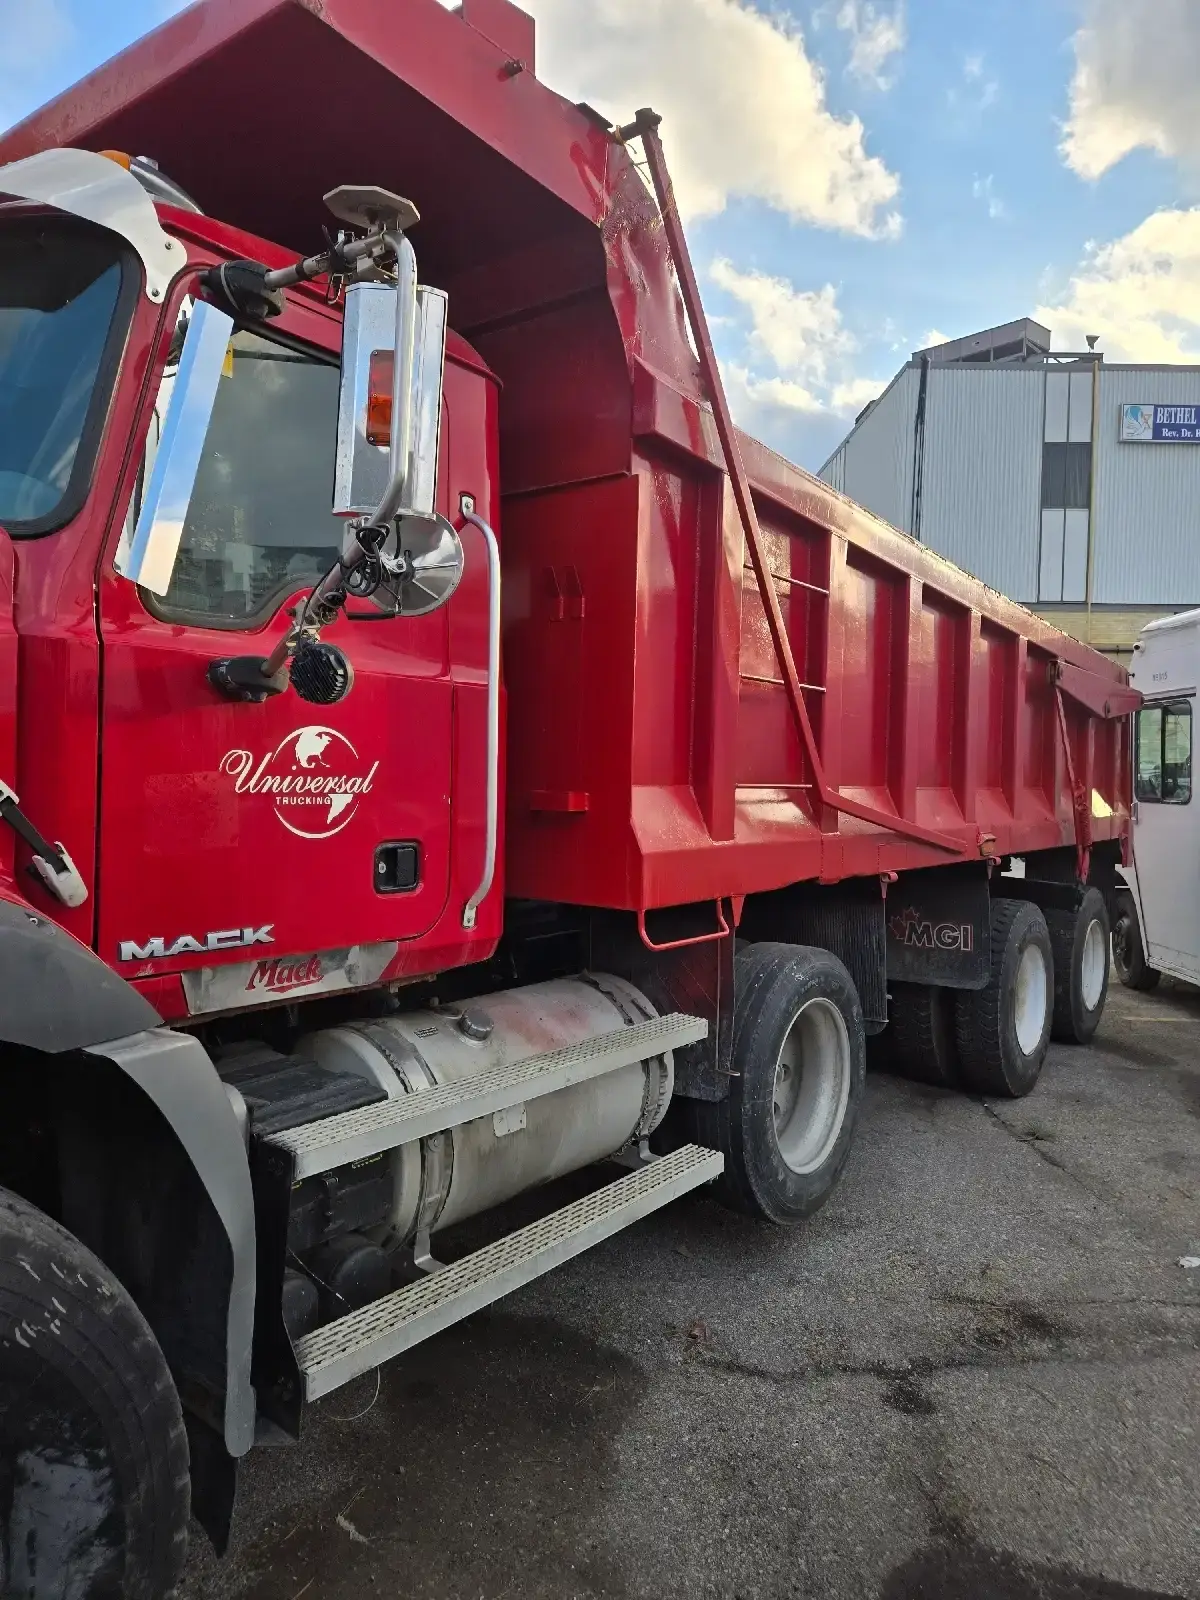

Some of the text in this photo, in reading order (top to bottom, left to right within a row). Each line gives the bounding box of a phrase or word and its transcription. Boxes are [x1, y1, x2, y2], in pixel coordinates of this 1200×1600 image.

[1156, 407, 1197, 425] BETHEL
[1162, 428, 1179, 438] Rev.
[1181, 428, 1193, 438] Dr.
[219, 750, 380, 794] Universal
[276, 796, 332, 805] TRUCKING
[119, 923, 275, 962] MACK
[904, 921, 974, 952] MGI
[245, 953, 324, 993] Mack
